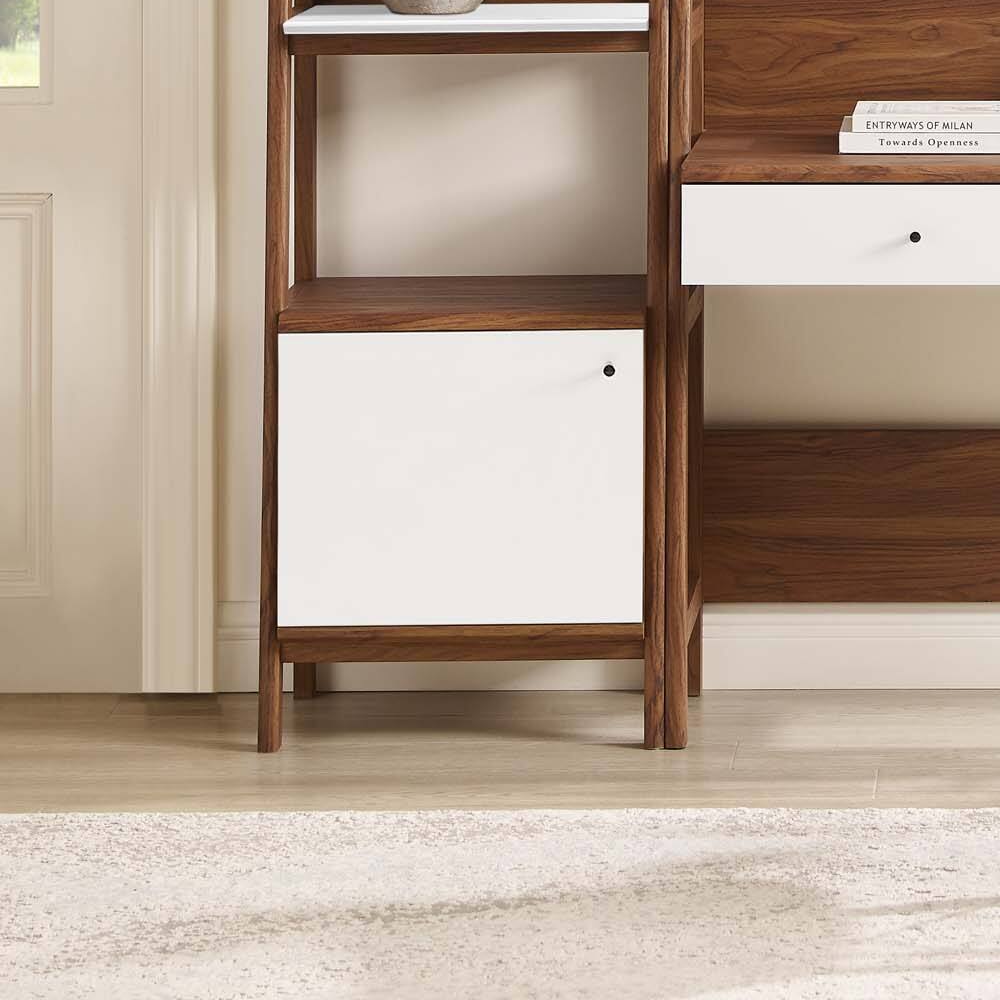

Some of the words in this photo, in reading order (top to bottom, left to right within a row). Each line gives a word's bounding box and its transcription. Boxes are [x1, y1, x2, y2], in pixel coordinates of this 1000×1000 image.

[866, 120, 924, 130] ENTRYWAYS
[926, 120, 940, 130] OF
[942, 120, 973, 130] MILAN
[878, 138, 923, 147] Towards
[927, 138, 979, 148] Openness
